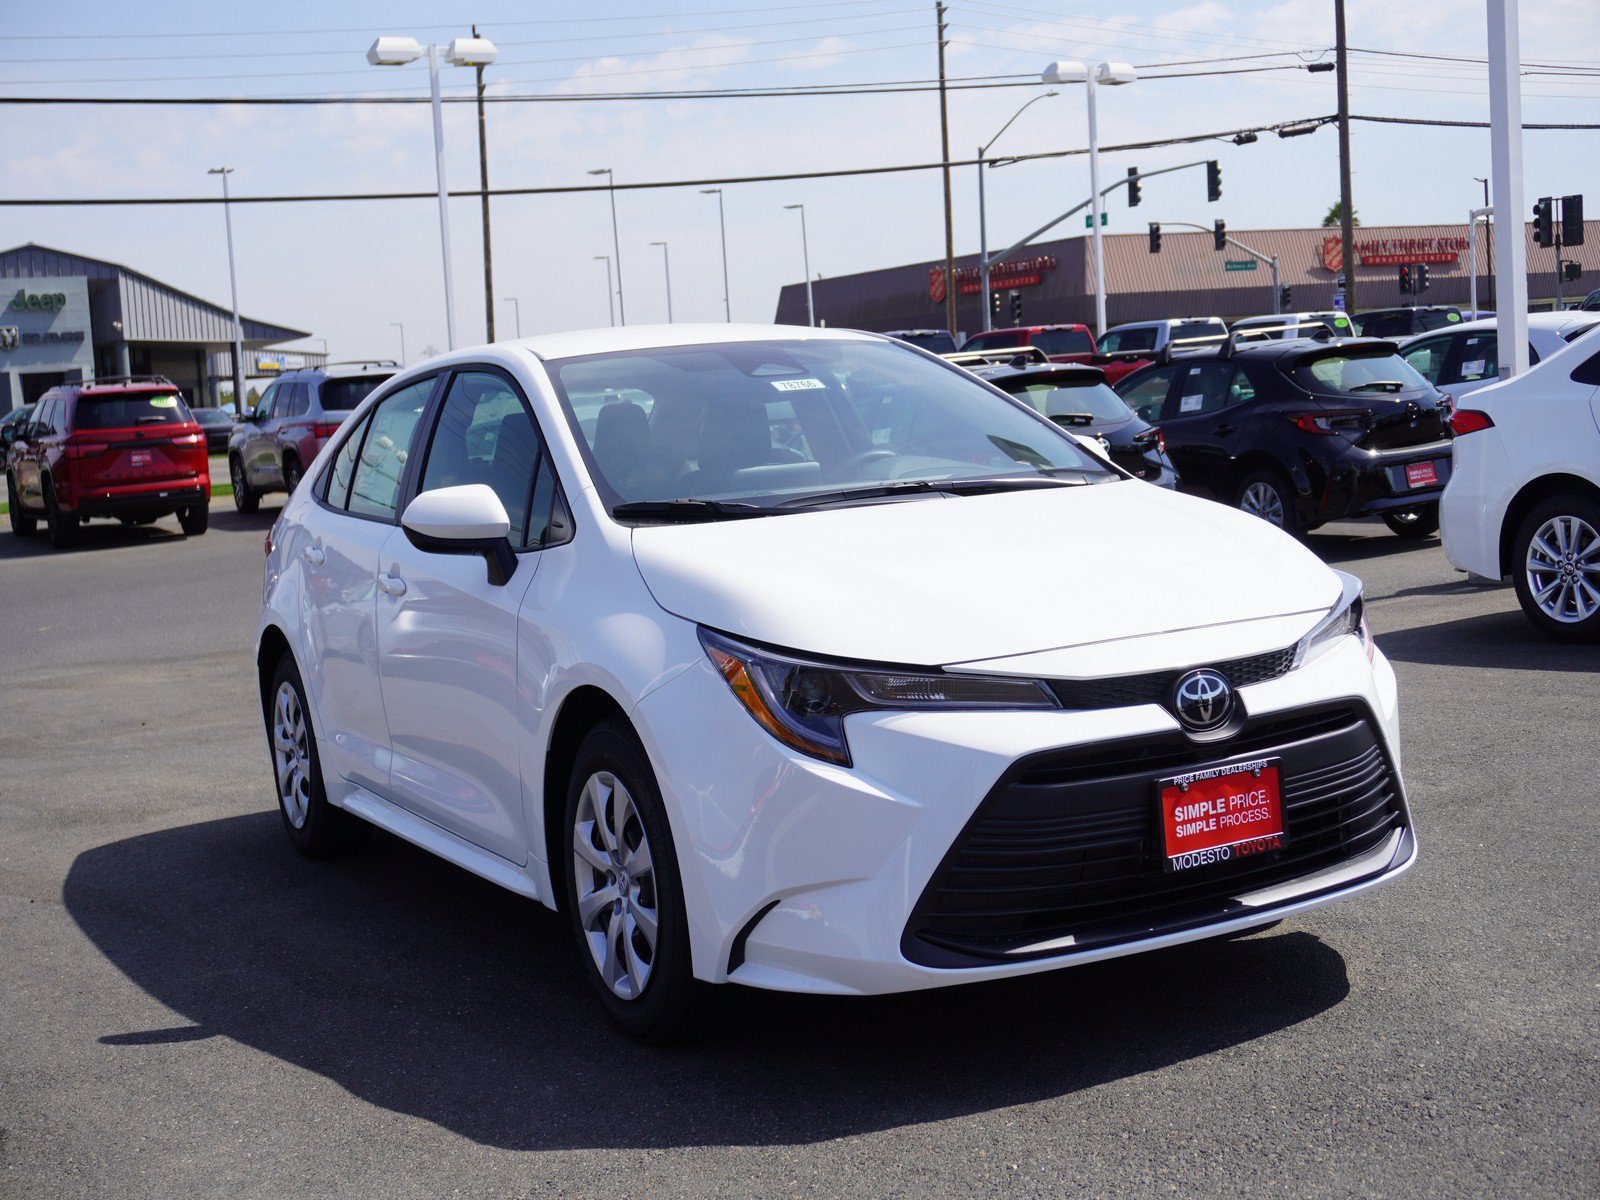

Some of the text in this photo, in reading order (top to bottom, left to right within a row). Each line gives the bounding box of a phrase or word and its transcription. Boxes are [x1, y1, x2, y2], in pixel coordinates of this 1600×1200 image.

[1353, 238, 1470, 257] AMILY THRIFT STOR
[1369, 254, 1452, 265] DONATION CENTER
[10, 289, 66, 312] Jeep
[778, 381, 816, 389] 78766
[1174, 760, 1268, 786] PRICE FAMILY DEALERSHIPS
[1174, 789, 1270, 822] SIMPLE PRICE.
[1176, 807, 1271, 838] SIMPLE PROCESS.
[1173, 836, 1281, 871] MODESTO TOYOTA
